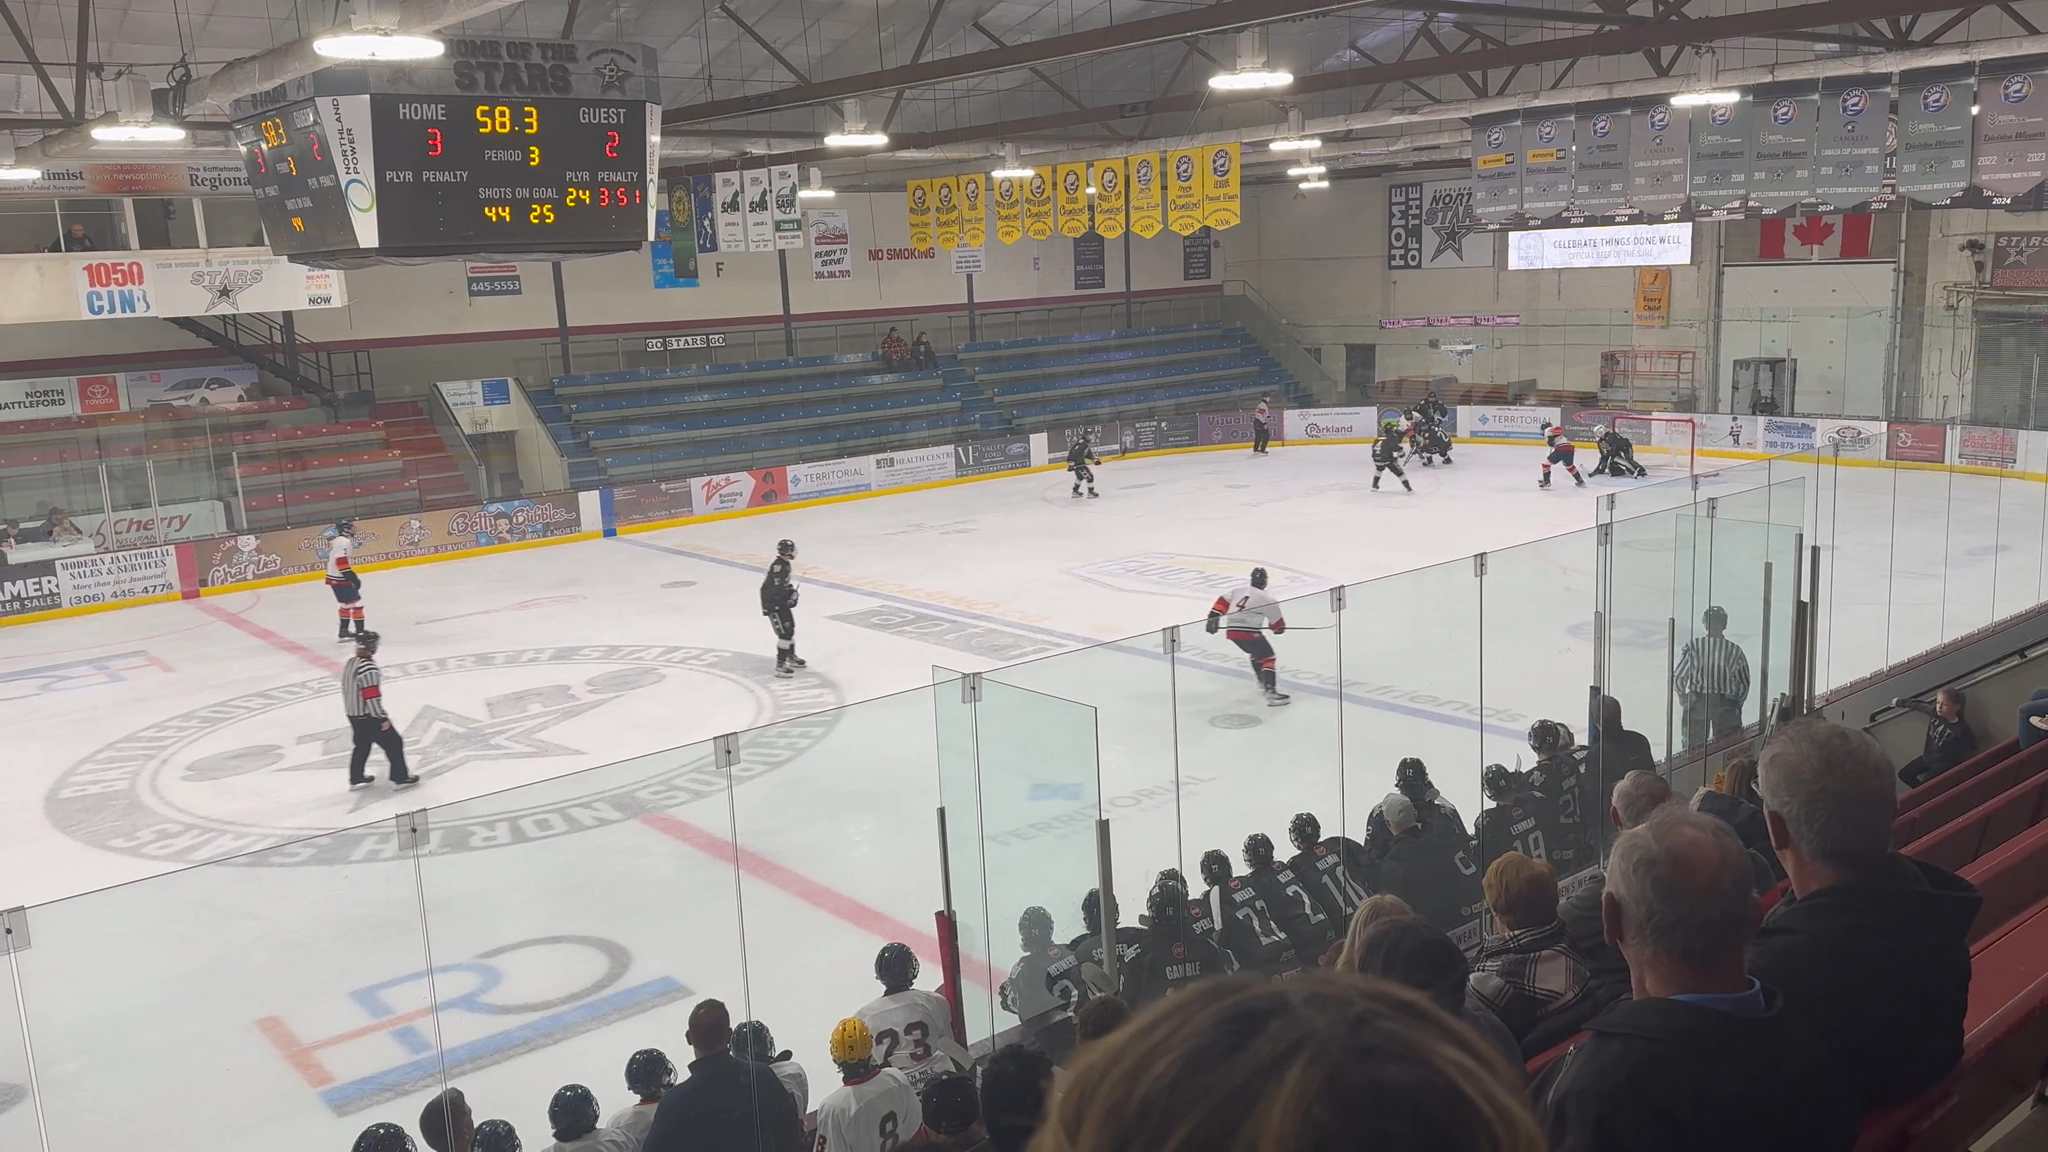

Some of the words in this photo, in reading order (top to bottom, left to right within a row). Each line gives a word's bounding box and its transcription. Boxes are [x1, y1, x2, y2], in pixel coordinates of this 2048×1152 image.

[505, 41, 534, 60] OF
[536, 42, 580, 63] THE
[453, 60, 573, 95] STARS
[2005, 74, 2026, 88] SJHL
[399, 103, 447, 121] HOME
[579, 107, 627, 124] GUEST
[476, 106, 538, 133] 58.3
[332, 98, 352, 175] NORTHLAND
[427, 127, 443, 157] 3
[1832, 134, 1870, 143] CANALTA
[1983, 133, 2014, 143] Division
[2014, 130, 2046, 140] Winners
[346, 127, 360, 175] POWER
[605, 131, 621, 158] 2
[1851, 147, 1880, 155] CHAMPIONS
[1905, 141, 1934, 150] Division
[1934, 139, 1965, 148] Winners
[484, 150, 522, 162] PERIOD
[529, 146, 540, 166] 3
[1720, 150, 1745, 158] Winners
[1756, 151, 1781, 160] Division
[1781, 150, 1808, 158] Winners
[1977, 156, 1998, 165] 2022
[2026, 152, 2047, 162] 2023
[1865, 165, 1879, 174] 2019
[1902, 164, 1917, 172] 2019
[1951, 159, 1966, 168] 2020
[386, 171, 414, 182] PLYR
[422, 171, 469, 182] PENALTY
[566, 171, 590, 182] PLYR
[598, 171, 639, 182] PENALTY
[1753, 172, 1766, 180] 2018
[1795, 169, 1809, 178] 2019
[1820, 166, 1833, 175] 2018
[1981, 172, 2012, 180] BATTLEFORDS
[189, 173, 251, 191] Regiona
[1692, 176, 1707, 184] 2017
[1730, 173, 1745, 182] 2018
[478, 188, 513, 199] SHOTS
[515, 188, 530, 199] ON
[532, 188, 559, 199] GOAL
[1816, 186, 1848, 194] BATTLEFORDS
[1863, 185, 1880, 193] STARS
[1898, 184, 1933, 192] BATTLEFORDS
[1933, 182, 1950, 190] NORTH
[566, 188, 591, 207] 24
[599, 188, 641, 207] 3:51
[1991, 197, 2012, 205] 2024
[1408, 185, 1421, 229] THE
[1818, 204, 1835, 212] 2024
[1870, 202, 1888, 210] 2024
[484, 206, 511, 223] 44
[529, 204, 555, 223] 25
[1614, 215, 1629, 223] 2024
[1663, 213, 1678, 221] 2024
[1711, 209, 1728, 217] 2024
[1178, 222, 1195, 232] 2005
[1214, 218, 1231, 227] 2006
[1391, 187, 1406, 267] HOME
[1553, 238, 1598, 249] CELEBRATE
[1600, 237, 1631, 247] THINGS
[1633, 235, 1657, 246] DONE
[1658, 235, 1682, 245] WELL
[1997, 236, 2048, 247] STARS
[815, 249, 839, 260] READY
[838, 247, 848, 256] TO
[868, 248, 885, 261] NO
[887, 247, 936, 261] SMOKING
[1407, 237, 1420, 267] OF
[1568, 251, 1595, 260] OFFICIAL
[1596, 251, 1611, 259] BEER
[1612, 250, 1622, 259] OF
[1623, 249, 1635, 258] THE
[820, 257, 845, 268] SERVE!
[82, 261, 145, 288] 1050
[715, 262, 724, 277] F
[190, 267, 264, 286] STARS
[470, 280, 520, 292] 445-5553
[308, 296, 332, 306] NOW
[1643, 296, 1662, 305] Every
[1643, 304, 1661, 312] Child
[646, 340, 663, 350] GO
[666, 338, 707, 348] STARS
[710, 336, 725, 346] GO
[25, 388, 65, 399] NORTH
[84, 398, 115, 406] TOYOTA
[474, 422, 487, 431] EXIT
[1206, 413, 1246, 427] Visual
[1308, 424, 1353, 434] Parkland
[982, 443, 1005, 452] VALLEY
[895, 455, 926, 466] HEALTH
[926, 451, 955, 461] CENTRE
[803, 467, 865, 483] TERRITORIAL
[719, 491, 743, 500] Building
[719, 497, 738, 505] Group
[113, 513, 193, 535] Cherry
[447, 510, 497, 537] Betty
[510, 502, 577, 528] Bubbles
[526, 530, 544, 540] HWY
[553, 525, 582, 536] NORTH
[60, 557, 106, 572] MODERN
[108, 546, 173, 566] JANITORIAL
[281, 563, 313, 575] GREAT
[388, 546, 435, 561] CUSTOMER
[437, 540, 477, 554] SERVICE!!
[69, 567, 103, 581] SALES
[106, 566, 114, 575] &
[117, 558, 167, 574] SERVICES
[72, 582, 93, 592] More
[93, 579, 111, 589] than
[111, 576, 127, 588] just
[68, 591, 106, 608] (306)
[110, 582, 175, 600] 445-4774
[24, 595, 61, 609] SALES
[1235, 595, 1250, 612] 4
[573, 645, 732, 666] STARS
[986, 774, 1219, 848] TERRITORIAL
[1510, 816, 1537, 836] LEHMAN
[1231, 887, 1257, 904] WEBER
[1166, 907, 1174, 916] 16
[1236, 900, 1288, 946] 22
[1455, 926, 1478, 946] WEAR
[1165, 961, 1201, 981] GAMBLE
[874, 1019, 933, 1069] 23
